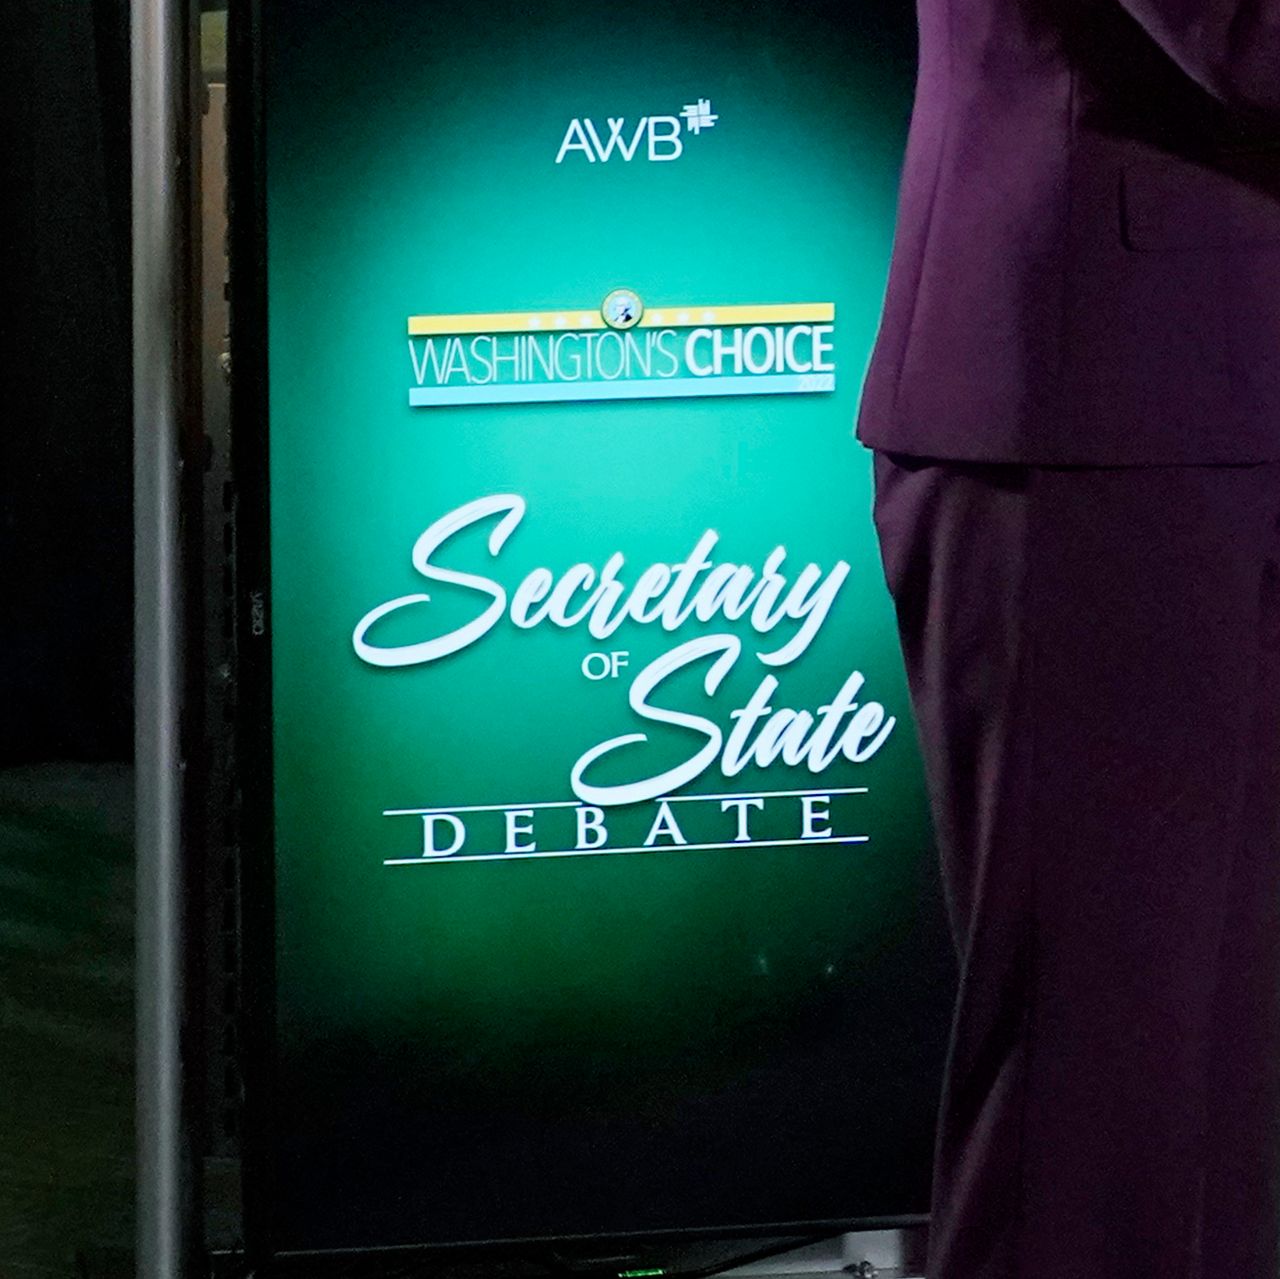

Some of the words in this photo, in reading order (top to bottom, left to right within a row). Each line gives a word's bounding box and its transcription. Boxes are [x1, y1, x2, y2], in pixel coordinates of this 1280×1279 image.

[555, 115, 683, 163] AWB
[408, 329, 680, 385] WASHINGTON'S
[684, 324, 835, 377] CHOICE
[352, 493, 852, 667] Secretary
[580, 651, 630, 680] OF
[570, 633, 897, 807] State
[421, 795, 834, 858] DEBATE
